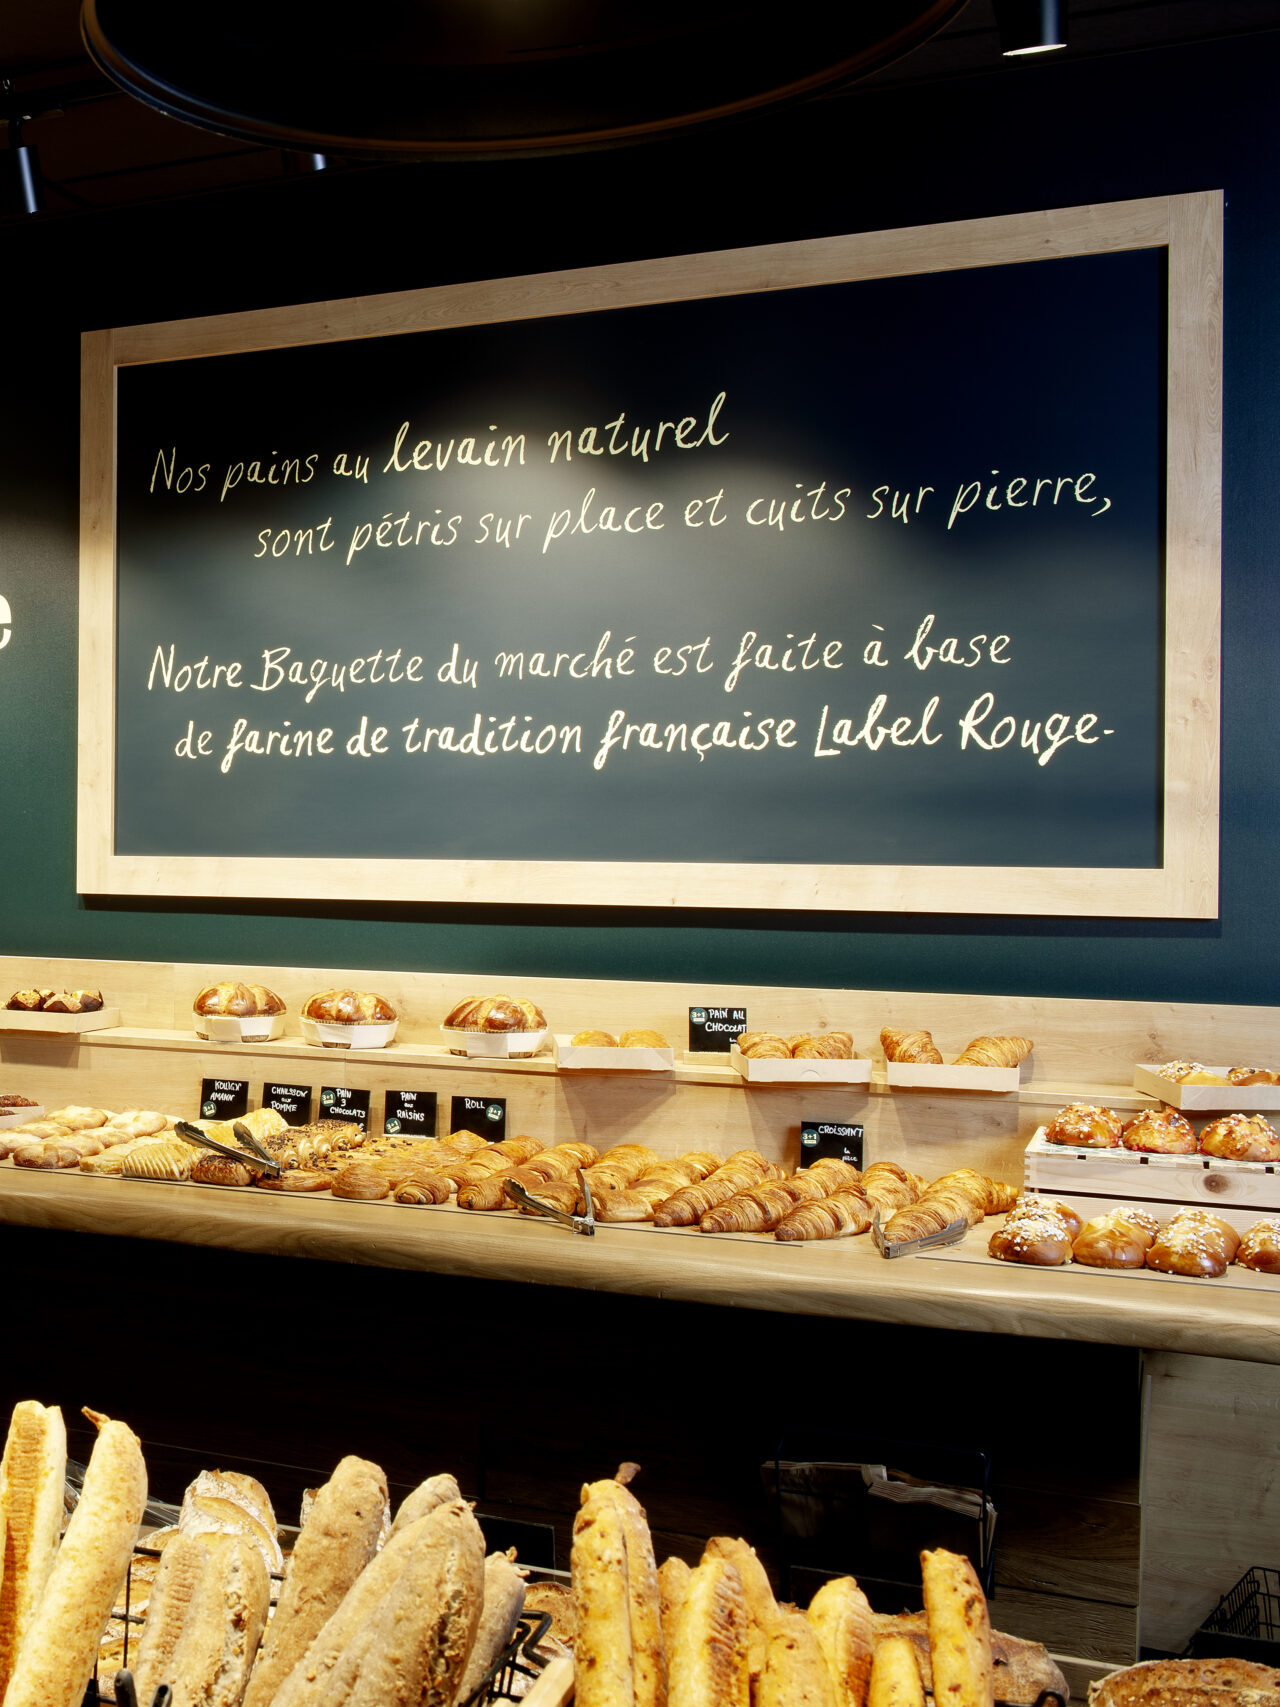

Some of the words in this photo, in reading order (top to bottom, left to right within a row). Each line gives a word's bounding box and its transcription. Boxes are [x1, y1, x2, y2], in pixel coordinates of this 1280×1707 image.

[150, 446, 211, 494] Nos
[220, 450, 319, 503] pains
[332, 453, 370, 484] au
[382, 420, 526, 474] levain
[547, 391, 730, 464] naturel
[253, 516, 335, 558] sont
[345, 510, 463, 566] pétris
[474, 512, 532, 549] sur
[542, 487, 665, 555] place
[684, 488, 727, 528] et
[745, 480, 852, 532] cuits
[866, 485, 935, 524] sur
[947, 469, 1112, 531] pierre,
[147, 643, 244, 693] Notre
[249, 645, 424, 704] Baguette
[436, 642, 479, 689] du
[494, 630, 637, 680] marché
[653, 636, 714, 676] est
[724, 631, 844, 693] faite
[862, 623, 889, 667] à
[903, 613, 1012, 671] base
[174, 719, 213, 760] de
[220, 718, 335, 774] farine
[345, 715, 389, 758] de
[401, 713, 582, 756] tradition
[592, 709, 798, 771] française
[813, 693, 944, 758] Label
[708, 1008, 728, 1019] PAIN
[733, 1010, 745, 1020] AU
[705, 1021, 747, 1033] CHOCOLAT
[336, 1088, 352, 1099] PAIN
[400, 1091, 418, 1101] PAIN
[270, 1100, 298, 1113] POMME
[340, 1098, 347, 1107] 3
[464, 1097, 486, 1110] ROLL
[329, 1106, 366, 1119] CHOCOLATS
[487, 1107, 502, 1117] 3+1
[386, 1121, 399, 1130] 3+1
